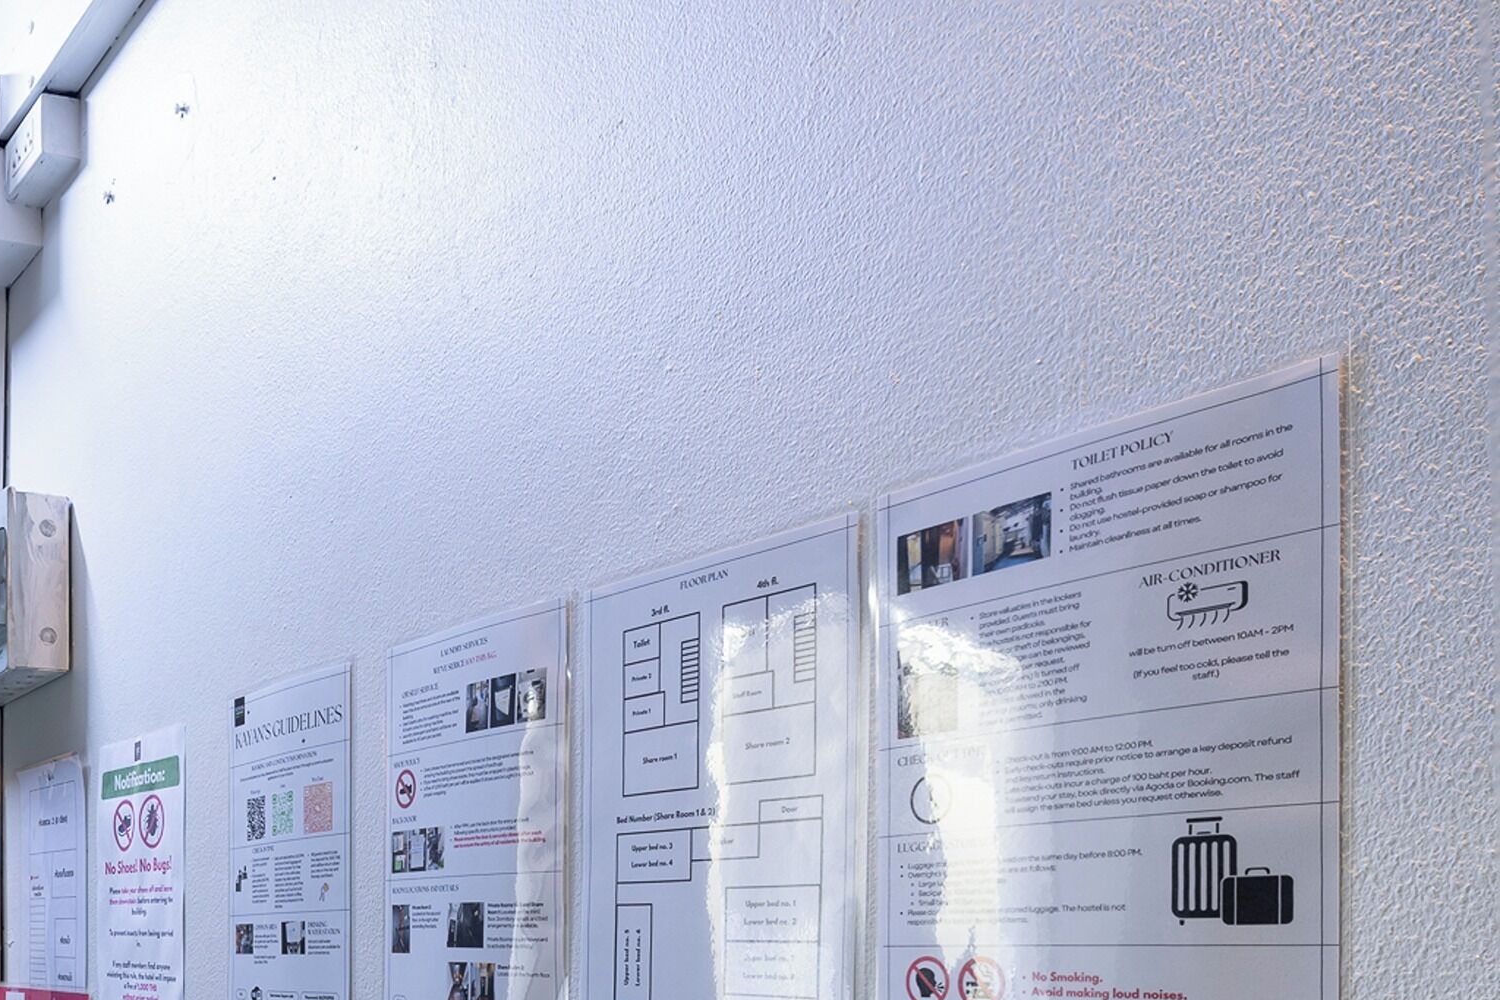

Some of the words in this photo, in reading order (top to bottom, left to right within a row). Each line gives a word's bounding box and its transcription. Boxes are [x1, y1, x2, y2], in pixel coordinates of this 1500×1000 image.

[1070, 446, 1117, 470] TOILET
[1120, 431, 1172, 456] POLICY
[1070, 476, 1098, 490] Shared
[1099, 464, 1145, 482] bathrooms
[1147, 460, 1161, 468] are
[1163, 448, 1202, 464] available
[1204, 444, 1217, 453] for
[1219, 439, 1230, 449] all
[1231, 432, 1262, 446] rooms
[1265, 428, 1273, 437] in
[1275, 423, 1292, 434] the
[1069, 503, 1080, 511] Do
[1081, 498, 1095, 507] not
[1096, 492, 1116, 503] flush
[1118, 486, 1142, 498] tissue
[1144, 479, 1171, 492] paper
[1172, 472, 1198, 484] down
[1200, 467, 1215, 476] the
[1218, 460, 1242, 472] toilet
[1256, 448, 1283, 463] avoid
[1069, 524, 1080, 532] Do
[1081, 519, 1095, 528] not
[1096, 516, 1111, 525] use
[1112, 496, 1181, 520] hostel-provided
[1184, 492, 1205, 503] soap
[1219, 478, 1266, 494] shampoo
[1268, 473, 1282, 483] for
[1069, 539, 1103, 552] Maintain
[1104, 528, 1150, 544] cleanliness
[1162, 521, 1171, 529] all
[1174, 516, 1200, 527] times.
[707, 569, 728, 582] PLAN
[1139, 549, 1280, 587] AIR-CONDITIONER
[1054, 592, 1081, 602] lockers
[1038, 606, 1057, 615] must
[1059, 602, 1079, 612] bring
[1035, 623, 1077, 637] responsible
[633, 639, 650, 648] Toilet
[1055, 641, 1090, 653] reviewed
[1129, 648, 1142, 657] will
[1177, 640, 1190, 649] off
[1192, 635, 1234, 647] between
[1237, 628, 1263, 640] 10AM
[1271, 624, 1293, 634] 2PM
[1143, 669, 1159, 678] you
[1161, 664, 1177, 674] feel
[1179, 663, 1194, 671] too
[1196, 659, 1219, 669] cold,
[1221, 655, 1253, 666] please
[1254, 650, 1271, 660] tell
[1272, 648, 1289, 657] the
[235, 723, 270, 749] KAYAN'S
[272, 704, 342, 737] GUIDELINES
[1065, 758, 1093, 767] require
[1095, 756, 1113, 765] prior
[1116, 752, 1142, 761] notice
[1155, 748, 1190, 757] arrange
[1200, 745, 1215, 753] key
[1218, 739, 1255, 751] deposit
[1257, 735, 1291, 746] refund
[1071, 747, 1088, 755] 9:00
[1090, 745, 1102, 753] AM
[1115, 741, 1136, 750] 12:00
[114, 764, 165, 791] Notification:
[1057, 768, 1103, 778] instructions.
[1091, 777, 1120, 786] charge
[1132, 773, 1146, 781] 100
[1148, 771, 1168, 779] baht
[1170, 770, 1186, 778] per
[1188, 768, 1211, 776] hour.
[1077, 789, 1098, 797] book
[1099, 785, 1131, 796] directly
[1146, 782, 1174, 792] Agoda
[1187, 776, 1252, 787] Booking.com.
[1254, 773, 1273, 781] The
[1275, 769, 1300, 780] staff
[1077, 800, 1092, 808] bed
[1094, 798, 1120, 806] unless
[1121, 797, 1137, 806] you
[1138, 794, 1172, 803] request
[1174, 789, 1223, 800] otherwise.
[629, 814, 652, 822] Number
[676, 810, 694, 818] Room
[104, 862, 115, 875] No
[117, 859, 137, 874] Shoes!
[139, 858, 151, 872] No
[153, 855, 171, 874] Bugs!
[1063, 853, 1077, 861] day
[1078, 851, 1106, 859] before
[1031, 972, 1046, 981] No
[1049, 972, 1102, 984] Smoking.
[1031, 987, 1061, 997] Avoid
[1066, 987, 1109, 1000] making
[1112, 988, 1140, 999] loud
[1143, 989, 1187, 1000] noises.
